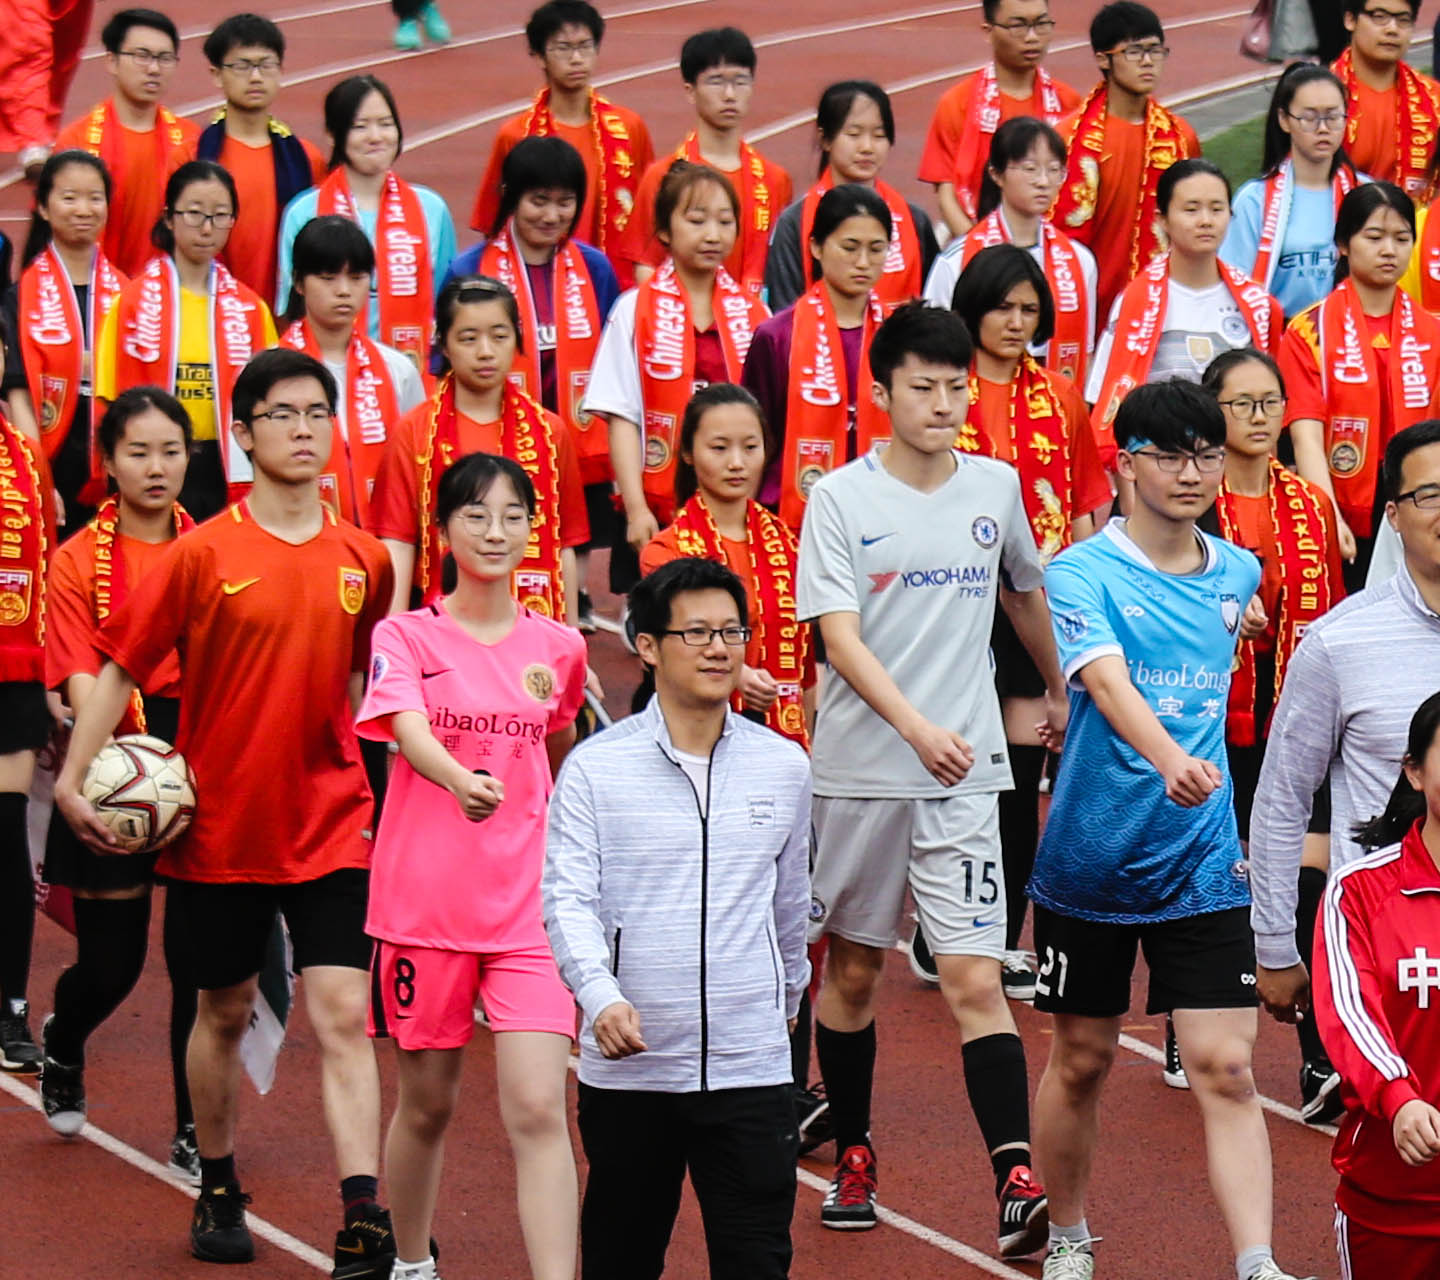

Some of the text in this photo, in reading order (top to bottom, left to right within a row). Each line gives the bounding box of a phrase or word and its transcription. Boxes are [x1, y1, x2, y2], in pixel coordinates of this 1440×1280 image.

[386, 230, 423, 298] dream
[1050, 245, 1080, 313] dream
[645, 294, 686, 381] Chinese
[1403, 342, 1432, 409] dream
[354, 374, 387, 446] dream
[799, 440, 832, 455] CFA
[517, 574, 549, 589] CFA
[1297, 538, 1331, 611] dream
[776, 595, 800, 670] dream
[960, 859, 998, 905] 15
[393, 957, 415, 1008] 8
[1037, 944, 1068, 998] 21
